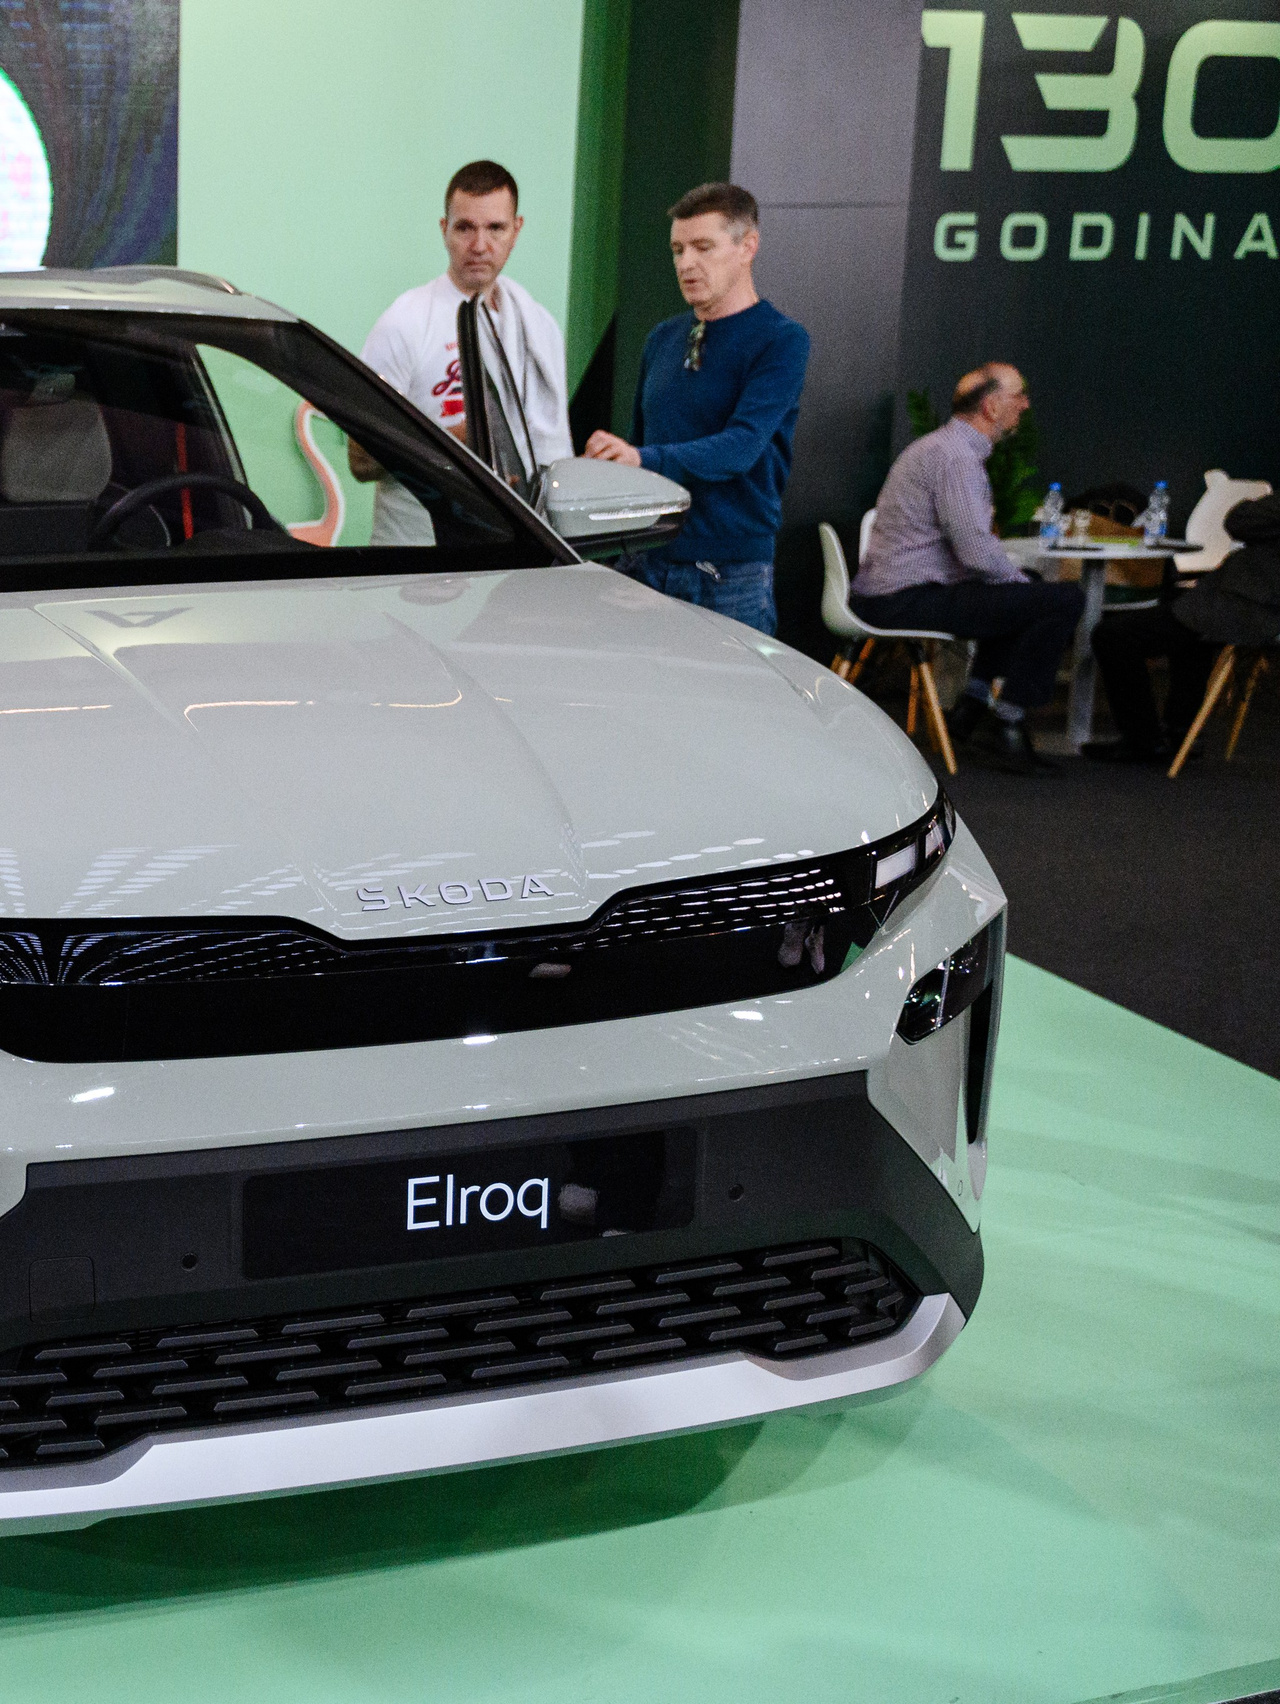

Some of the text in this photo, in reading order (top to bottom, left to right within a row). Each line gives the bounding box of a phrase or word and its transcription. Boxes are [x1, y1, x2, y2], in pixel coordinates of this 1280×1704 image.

[921, 10, 1280, 173] 130
[933, 211, 1280, 262] GODINA
[356, 874, 555, 911] SKODA
[406, 1173, 549, 1231] Elroq
